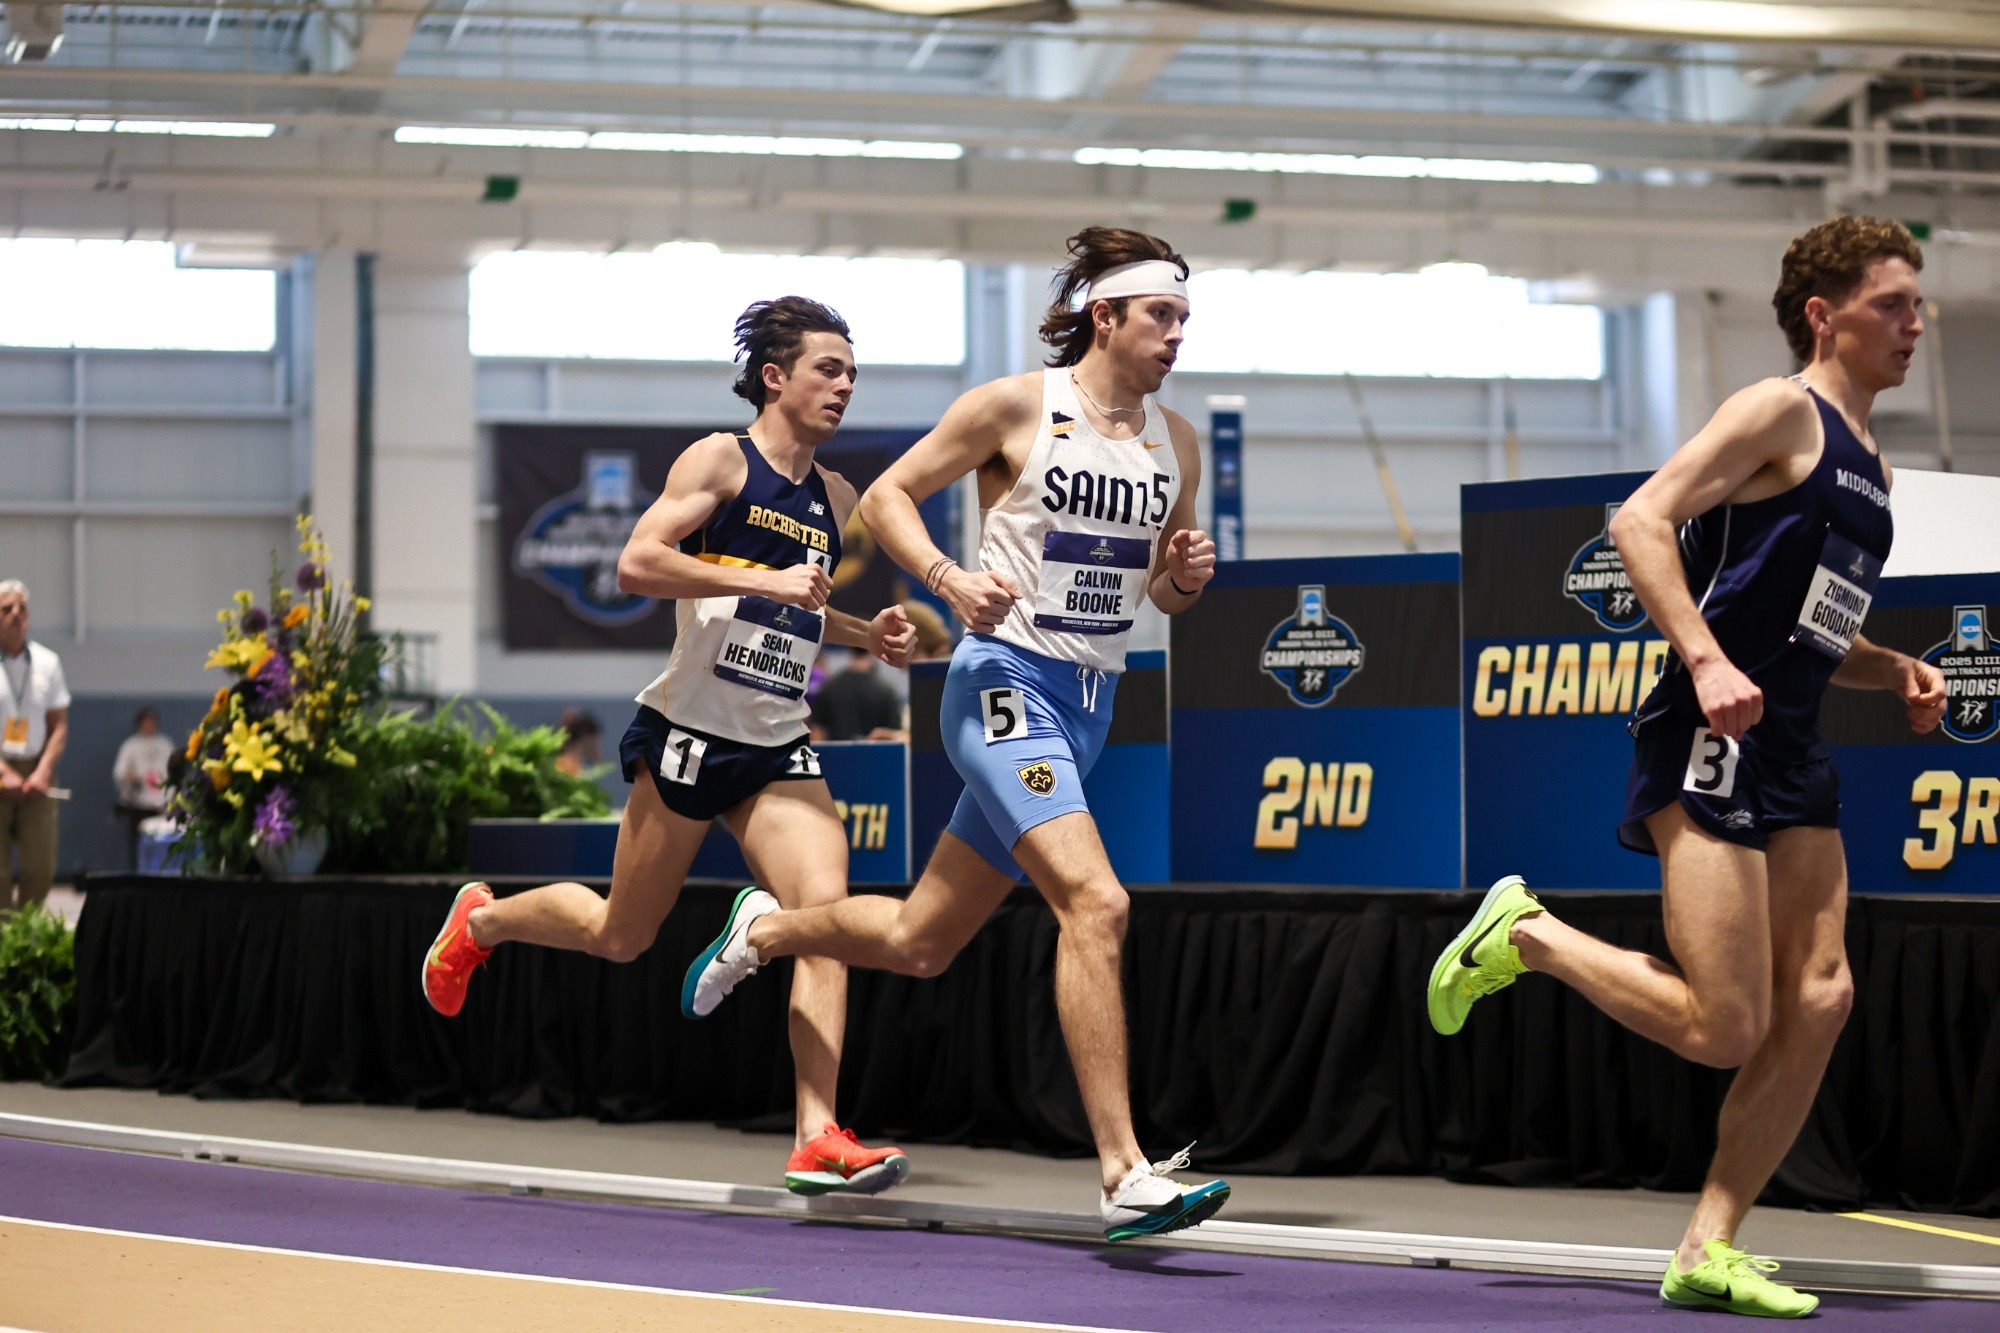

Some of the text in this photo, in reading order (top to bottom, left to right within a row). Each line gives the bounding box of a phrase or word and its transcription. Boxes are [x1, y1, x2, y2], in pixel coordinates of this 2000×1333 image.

[1150, 472, 1170, 524] 5
[746, 505, 829, 553] ROCHESTER
[1074, 570, 1123, 590] CALVIN
[1824, 578, 1866, 617] ZYGMUND
[1065, 590, 1124, 615] BOONE
[724, 642, 806, 684] HENDRICKS
[762, 632, 793, 655] SEAN
[1263, 649, 1361, 667] CHAMPIONSHIPS
[1940, 656, 1973, 667] 2025
[1959, 667, 1984, 675] TRACK
[989, 690, 1016, 738] 5
[675, 737, 694, 779] 1
[1694, 732, 1729, 791] 3
[1254, 756, 1374, 849] 2ND
[1903, 770, 2000, 870] 3R
[834, 800, 889, 849] TH
